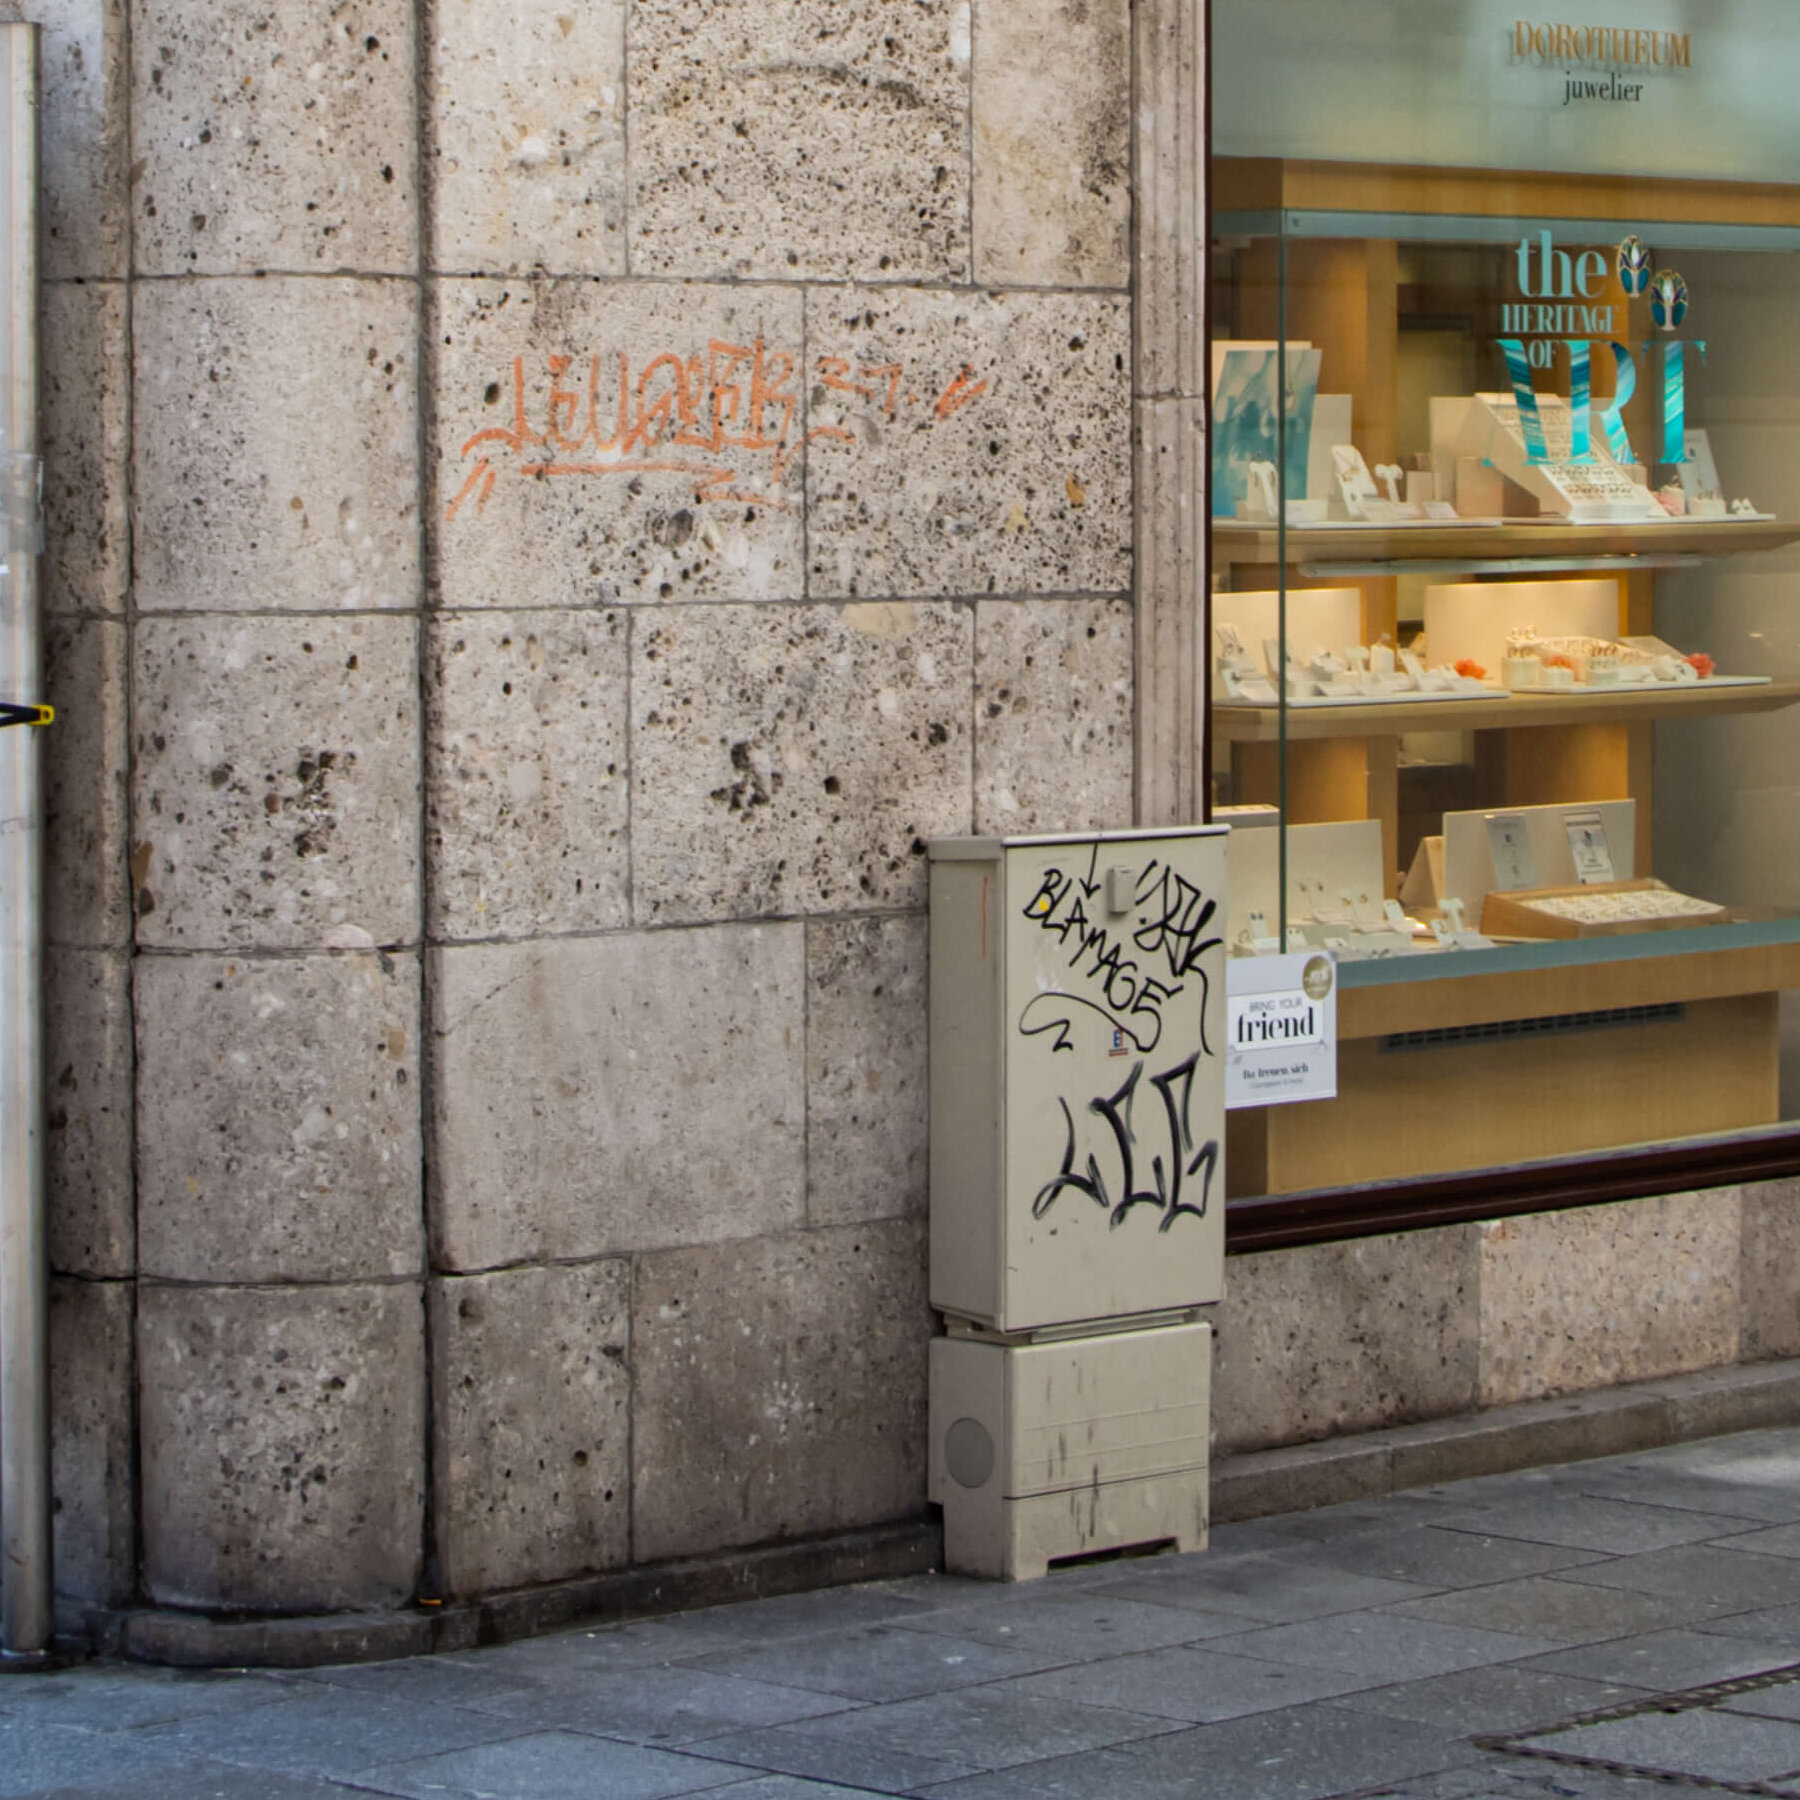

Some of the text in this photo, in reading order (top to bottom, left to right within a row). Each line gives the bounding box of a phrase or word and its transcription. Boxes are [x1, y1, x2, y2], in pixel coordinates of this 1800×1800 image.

[1515, 20, 1692, 68] DOROTHEUM
[1563, 70, 1644, 106] juwelier
[1516, 230, 1608, 298] the
[1503, 304, 1621, 334] HERITAGE
[1529, 340, 1557, 369] OF
[1237, 1006, 1315, 1043] friend
